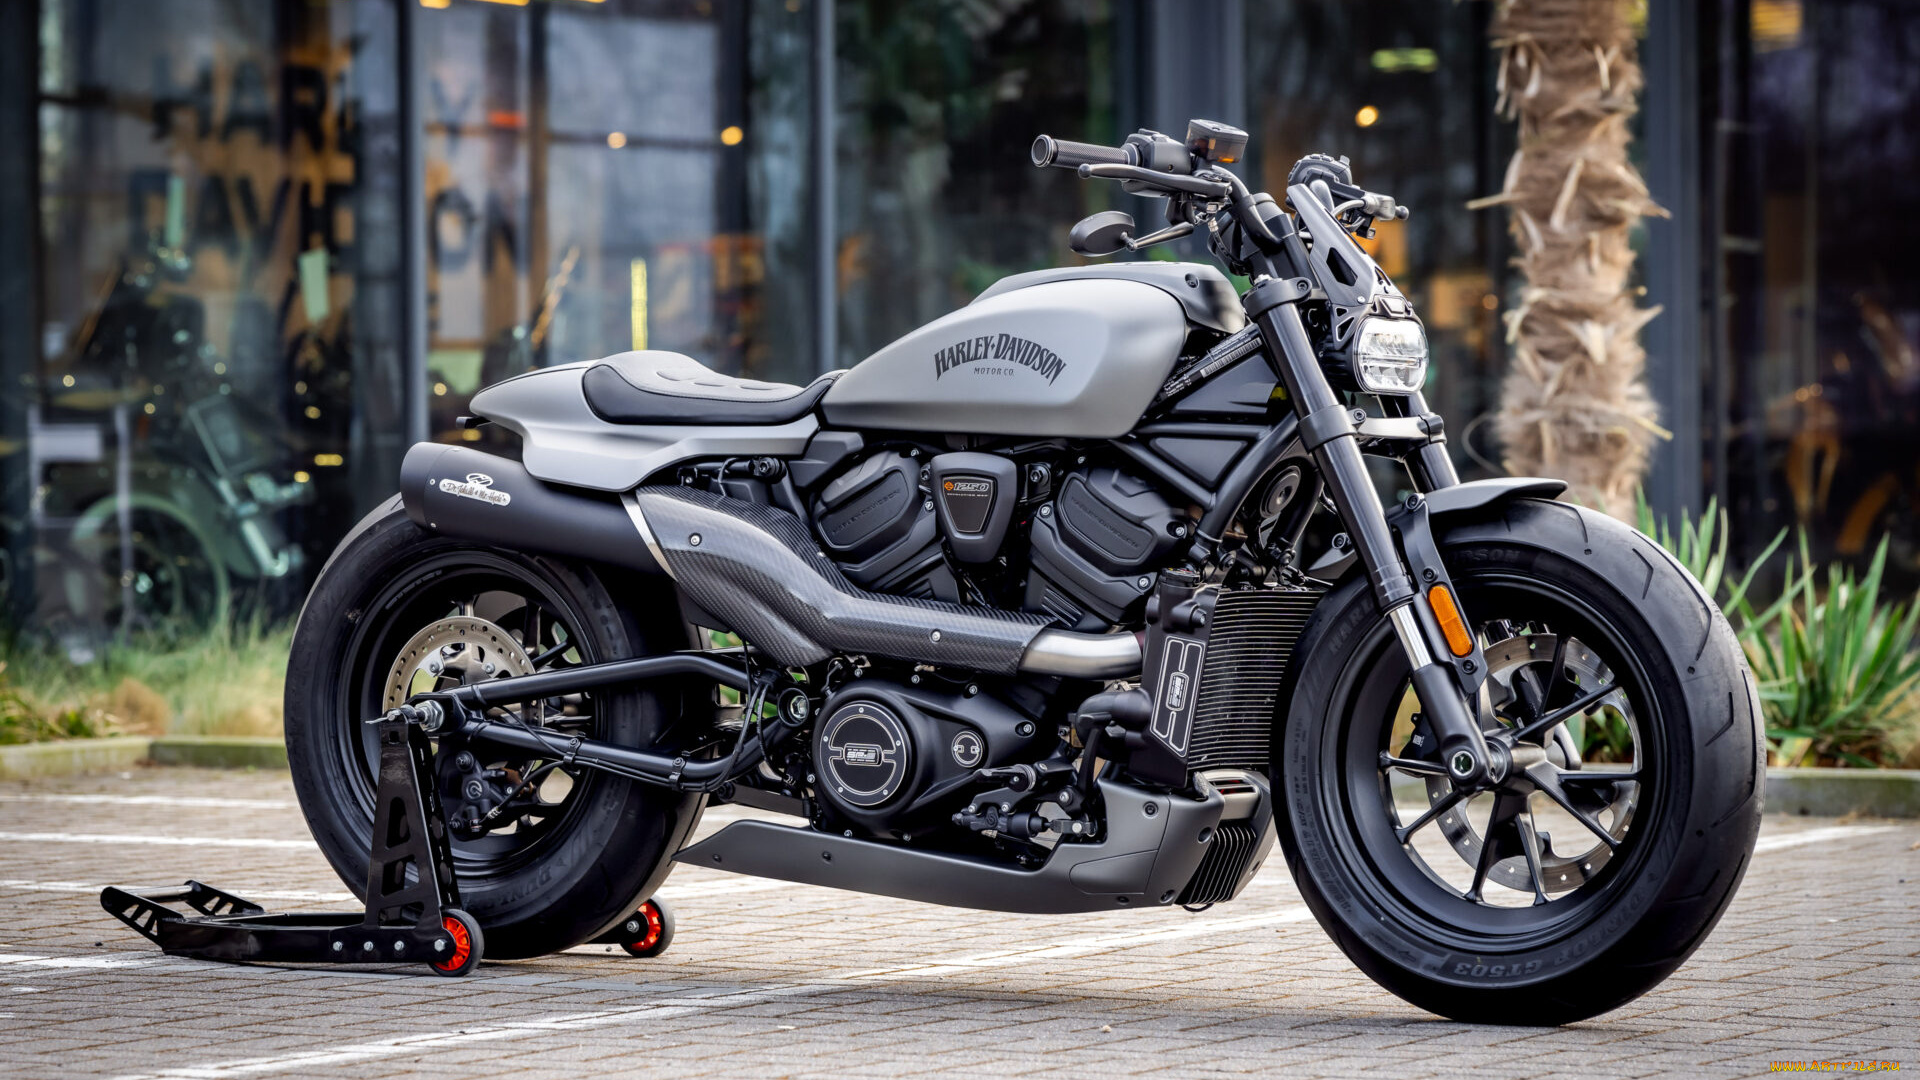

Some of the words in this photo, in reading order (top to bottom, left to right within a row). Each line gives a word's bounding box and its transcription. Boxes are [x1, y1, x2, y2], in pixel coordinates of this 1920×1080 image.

[974, 367, 1002, 376] MOTOR
[1004, 368, 1015, 376] CO.
[953, 482, 990, 492] 1250
[1453, 958, 1545, 979] GT503
